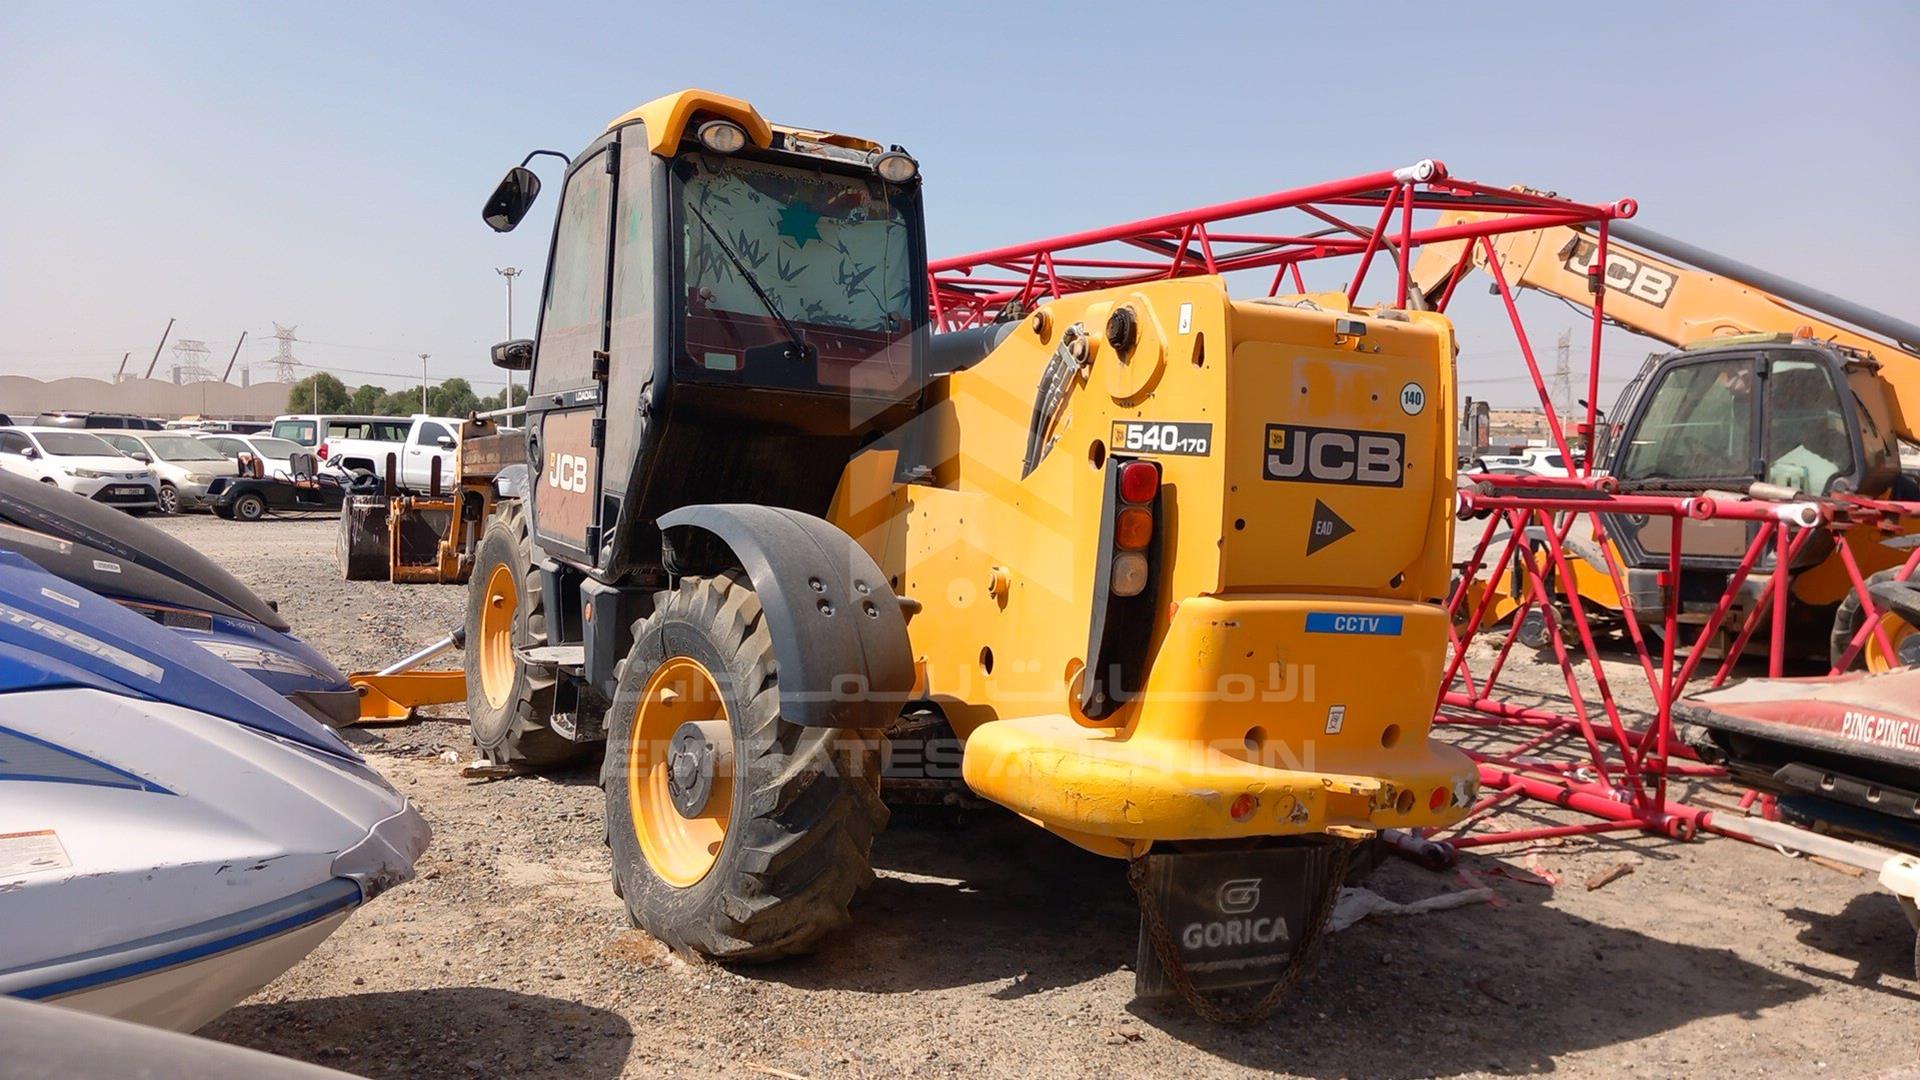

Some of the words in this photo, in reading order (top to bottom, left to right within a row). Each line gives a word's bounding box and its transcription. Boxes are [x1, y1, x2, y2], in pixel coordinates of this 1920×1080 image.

[1569, 246, 1673, 304] JCB
[575, 390, 598, 402] LOADALL
[1403, 391, 1422, 406] 140
[549, 453, 588, 494] JCB
[1267, 431, 1401, 484] JCB
[1315, 521, 1333, 536] EAD
[1333, 615, 1381, 633] CCTV
[1840, 711, 1875, 743] PING
[1182, 916, 1291, 950] GORICA
